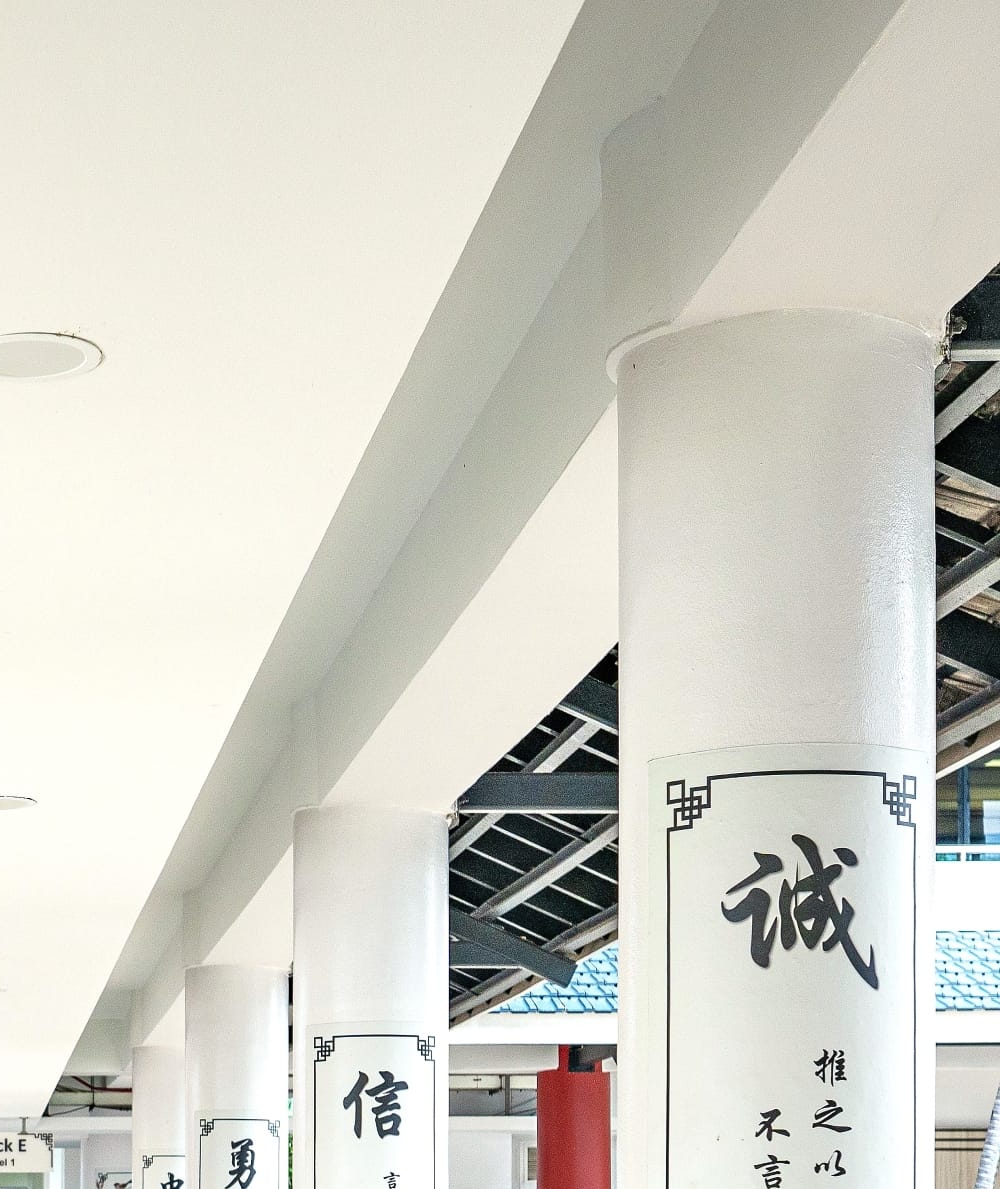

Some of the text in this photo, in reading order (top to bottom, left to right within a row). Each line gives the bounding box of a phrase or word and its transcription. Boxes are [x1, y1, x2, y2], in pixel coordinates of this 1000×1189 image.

[343, 1069, 409, 1140] 信
[18, 1139, 27, 1152] E
[10, 1158, 14, 1167] 1
[223, 1137, 256, 1189] 勇
